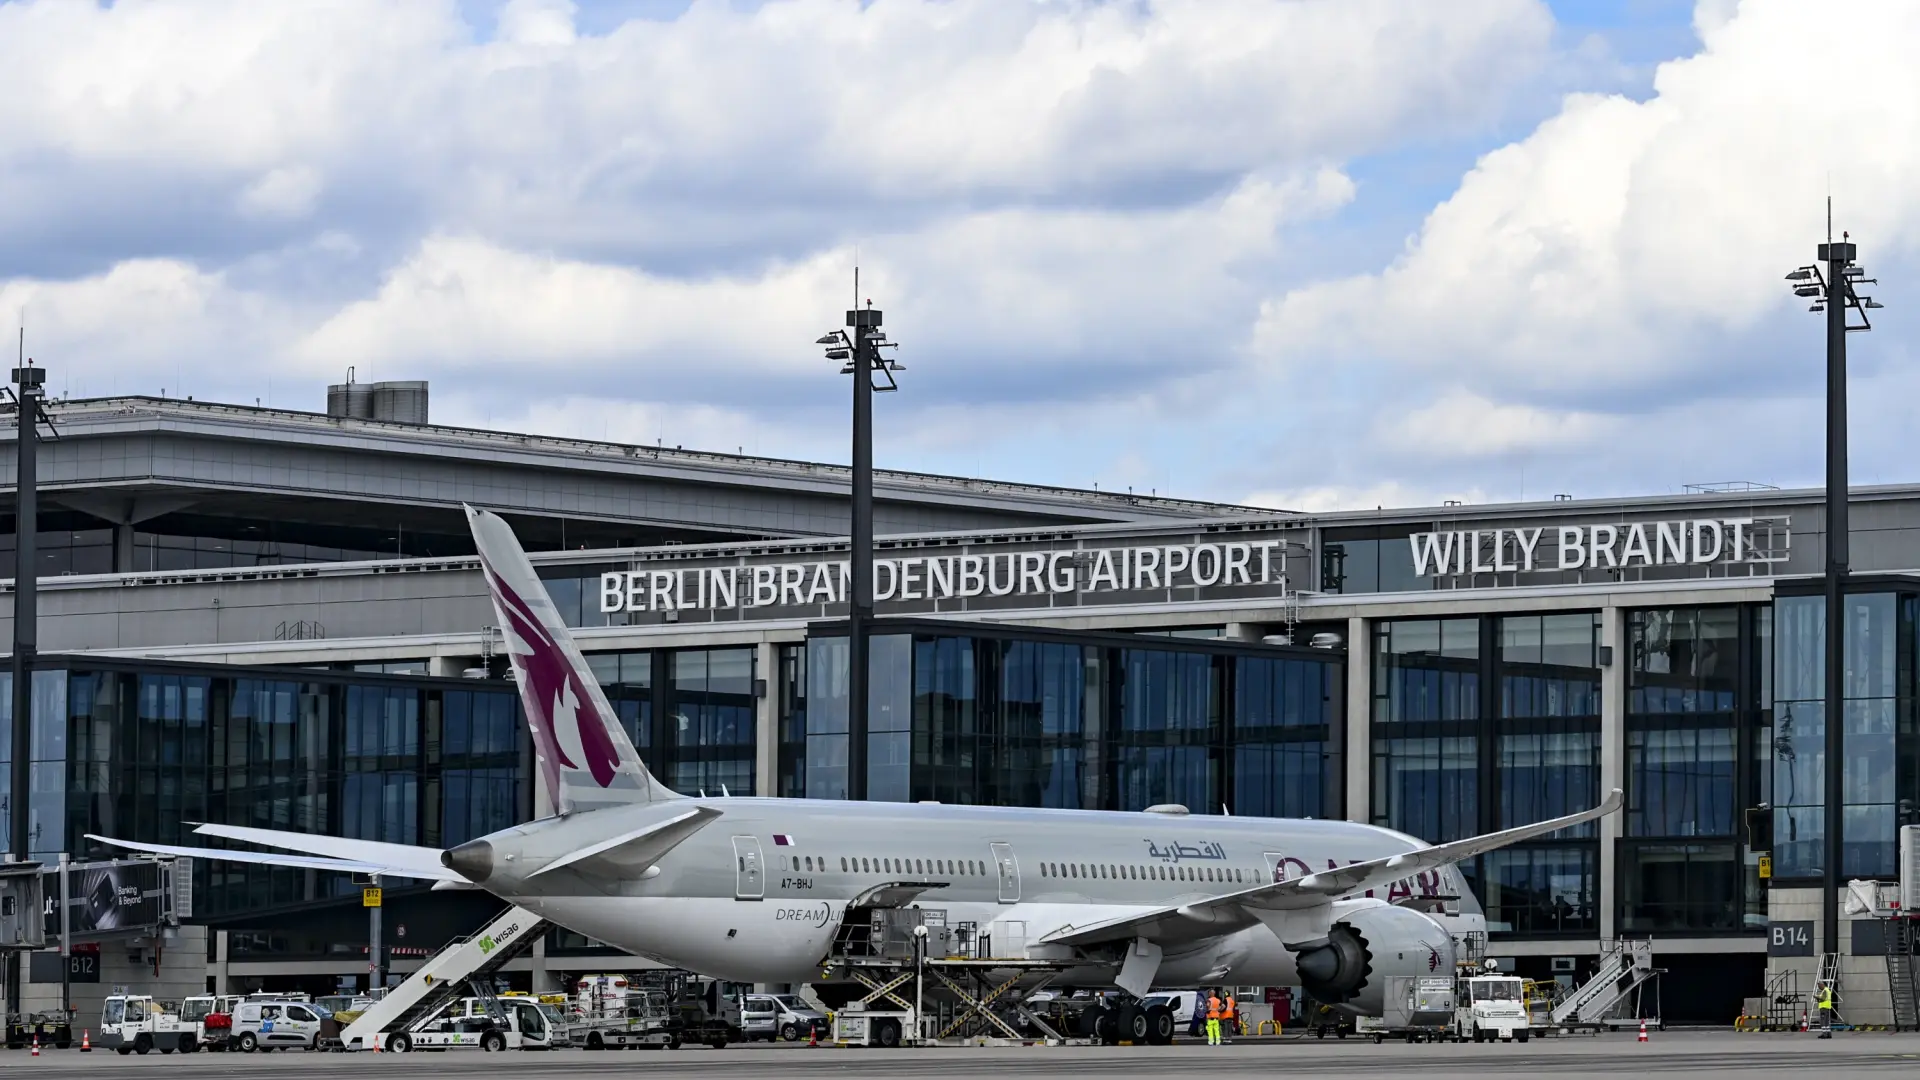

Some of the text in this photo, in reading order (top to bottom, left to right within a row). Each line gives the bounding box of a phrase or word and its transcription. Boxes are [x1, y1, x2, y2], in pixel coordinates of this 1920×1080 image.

[1410, 518, 1753, 577] WILLY BRANDT
[601, 568, 736, 612] BERLIN
[1088, 541, 1279, 591] AIRPORT
[1143, 839, 1226, 863] القطرية
[1762, 859, 1770, 867] B1
[118, 885, 138, 896] Banking
[781, 878, 813, 889] A7-BHJ
[366, 889, 379, 898] B12
[123, 895, 142, 907] Beyond
[1772, 927, 1809, 946] B14
[71, 956, 93, 973] B12
